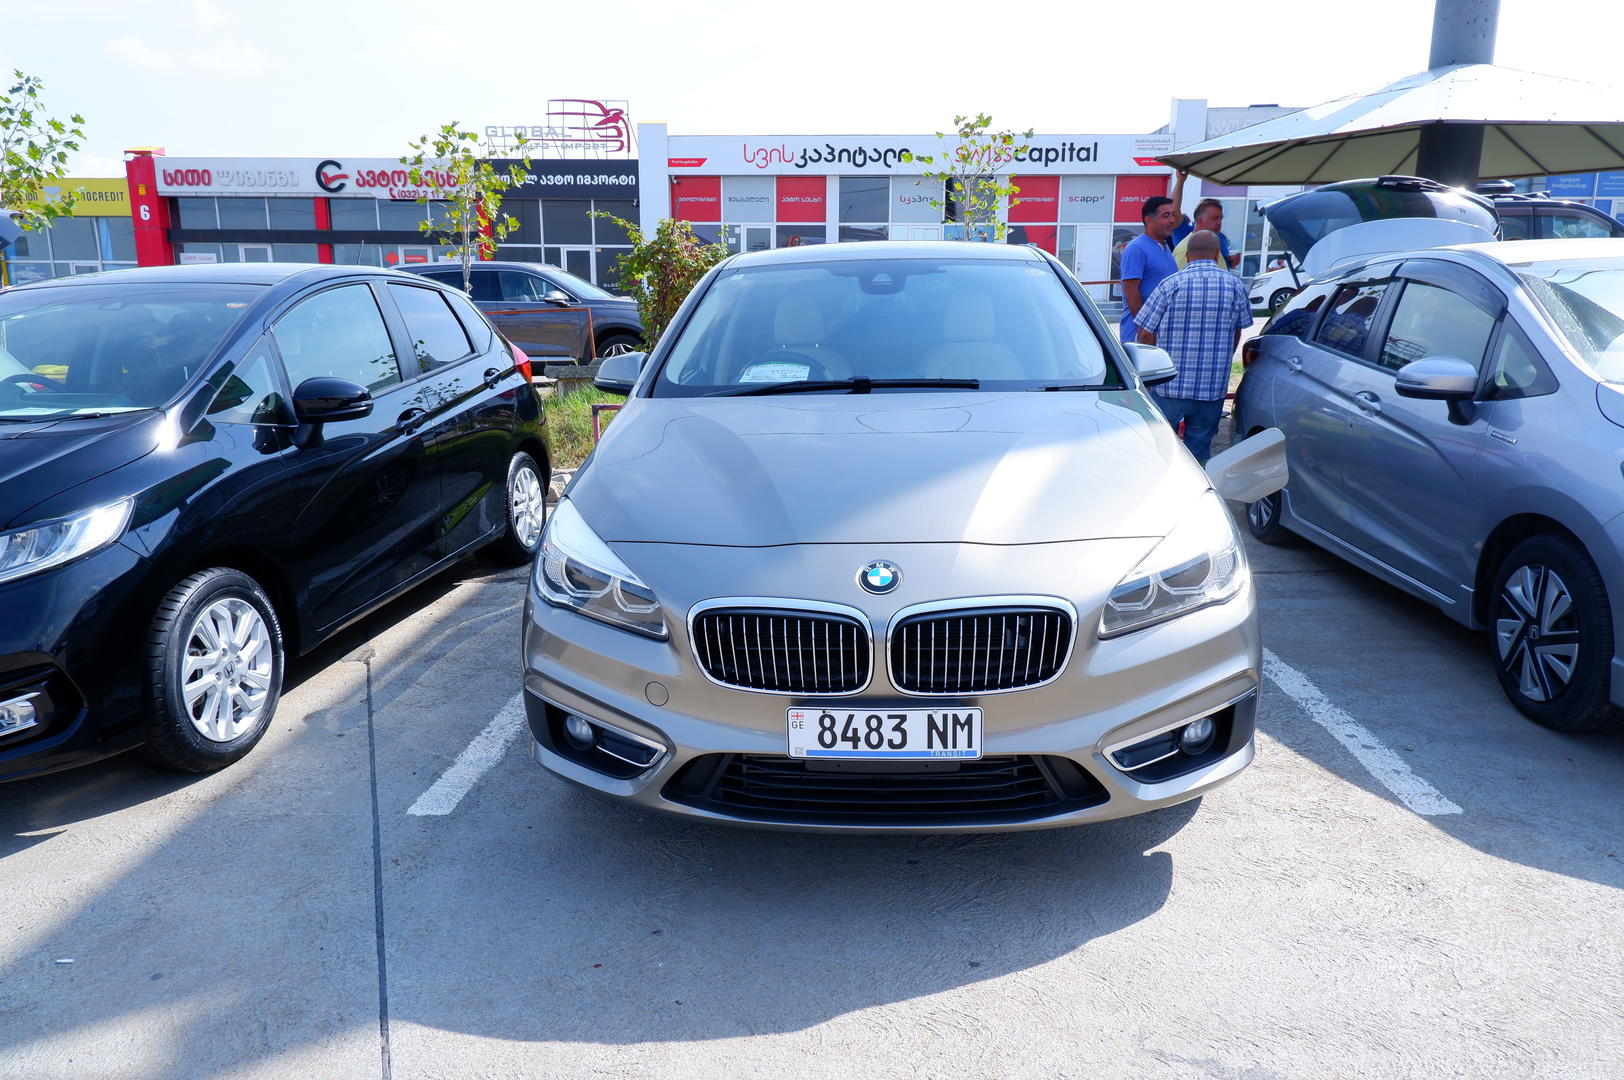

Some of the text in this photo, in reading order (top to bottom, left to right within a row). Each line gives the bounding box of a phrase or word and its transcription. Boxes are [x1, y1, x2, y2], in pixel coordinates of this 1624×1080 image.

[485, 126, 572, 137] GLOBAL
[355, 170, 409, 188] ავტო
[577, 174, 636, 185] იმპორტი
[140, 205, 151, 220] 6
[791, 721, 804, 729] GE
[817, 713, 973, 749] 8483 NM
